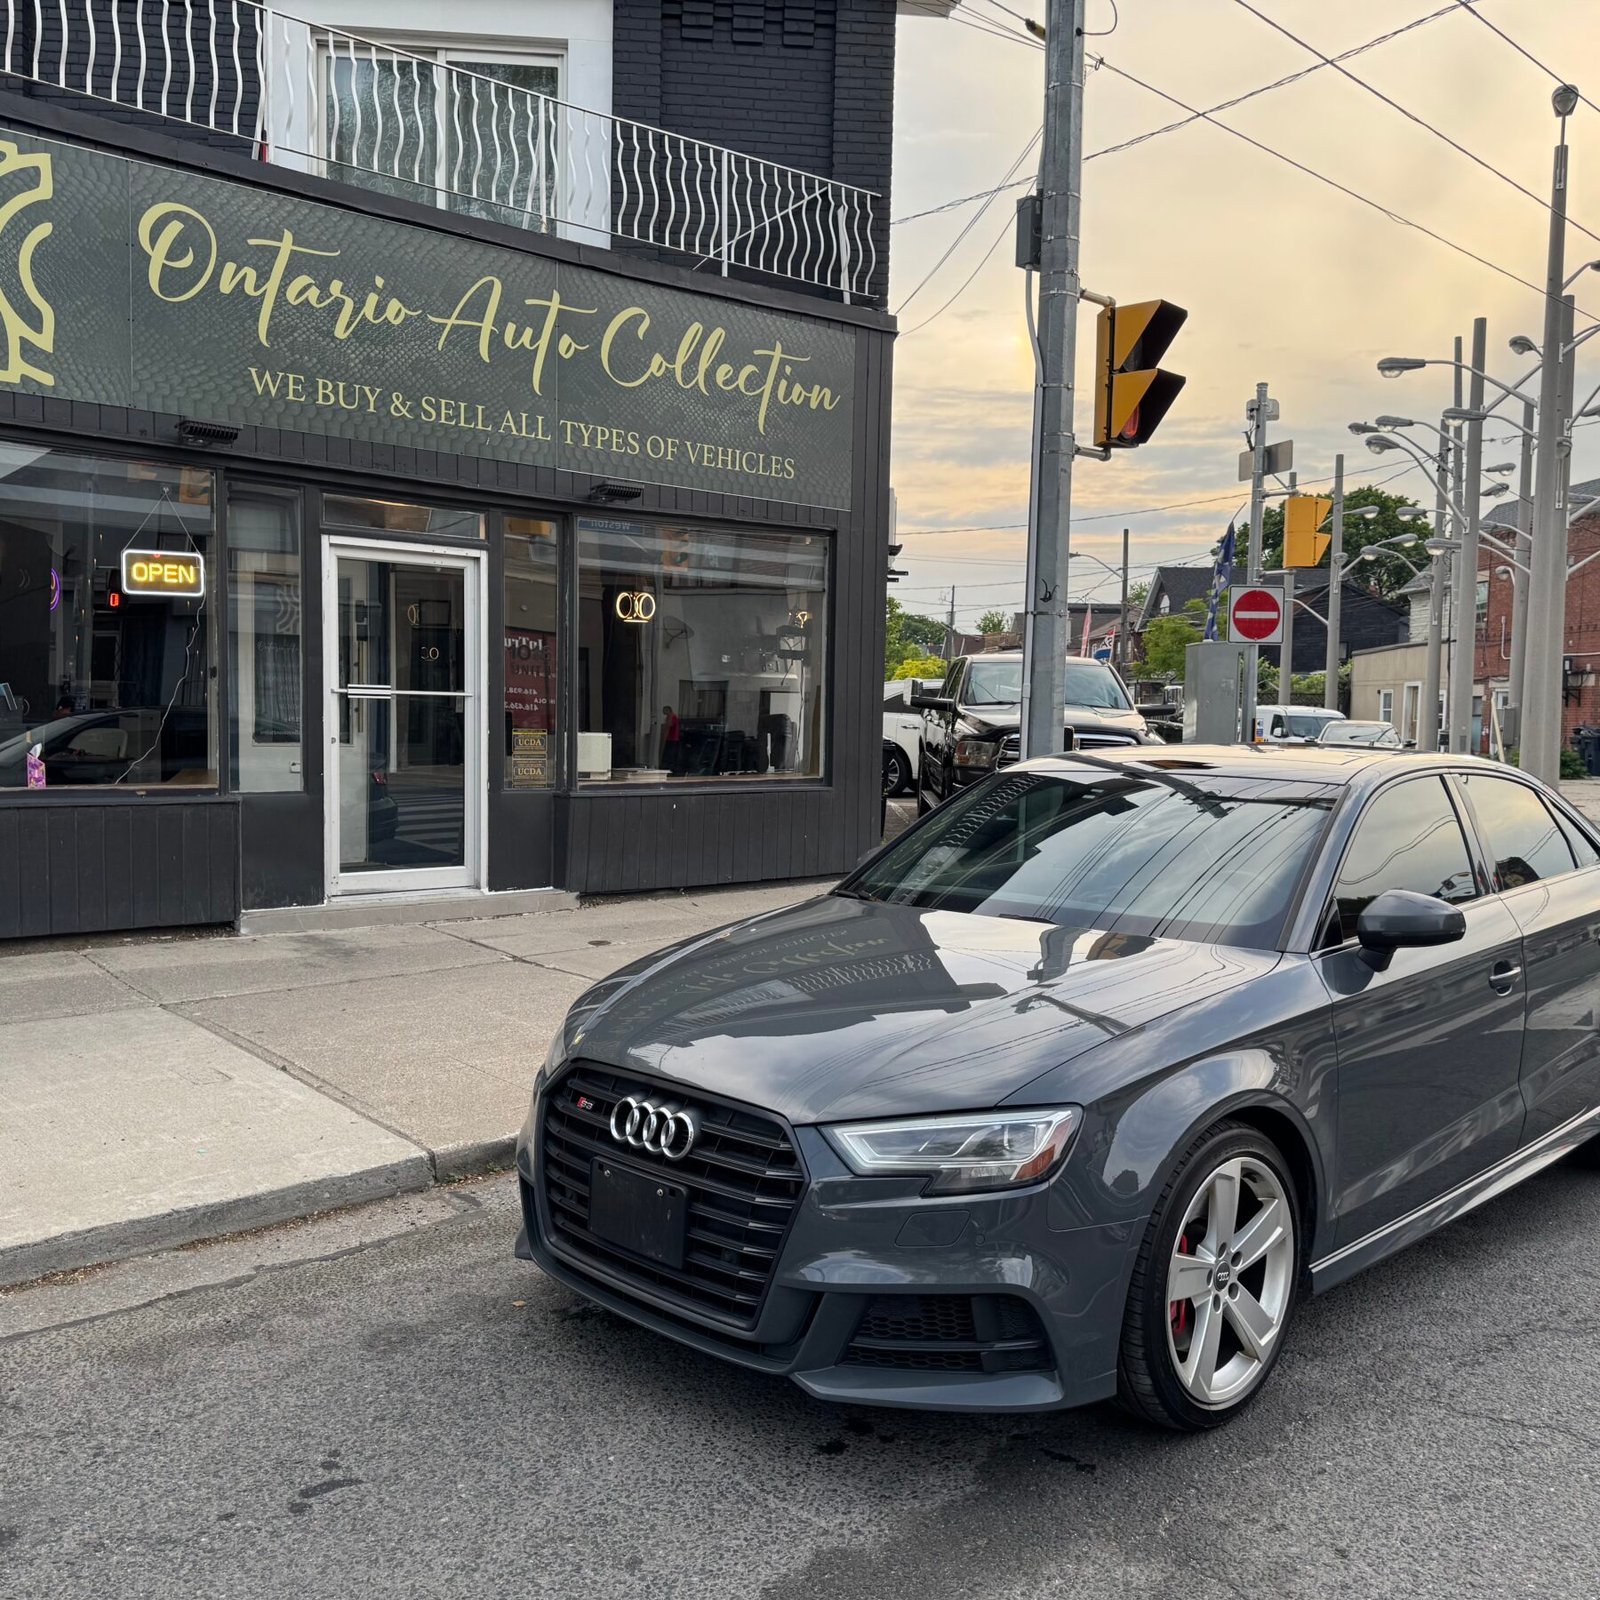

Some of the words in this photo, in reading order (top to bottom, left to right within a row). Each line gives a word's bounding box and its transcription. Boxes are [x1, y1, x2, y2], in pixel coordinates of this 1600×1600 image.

[137, 202, 421, 348] Ontario
[427, 275, 597, 396] Auto
[600, 306, 841, 434] Collection
[248, 367, 306, 402] WE
[315, 378, 384, 414] BUY
[390, 391, 412, 419] &
[420, 396, 493, 431] SELL
[498, 412, 552, 441] ALL
[559, 419, 640, 455] TYPES
[646, 435, 680, 461] OF
[684, 440, 796, 480] VEHICLES
[131, 561, 195, 584] OPEN
[518, 738, 542, 746] UCDA
[518, 767, 542, 775] UCDA
[577, 1097, 594, 1110] S3
